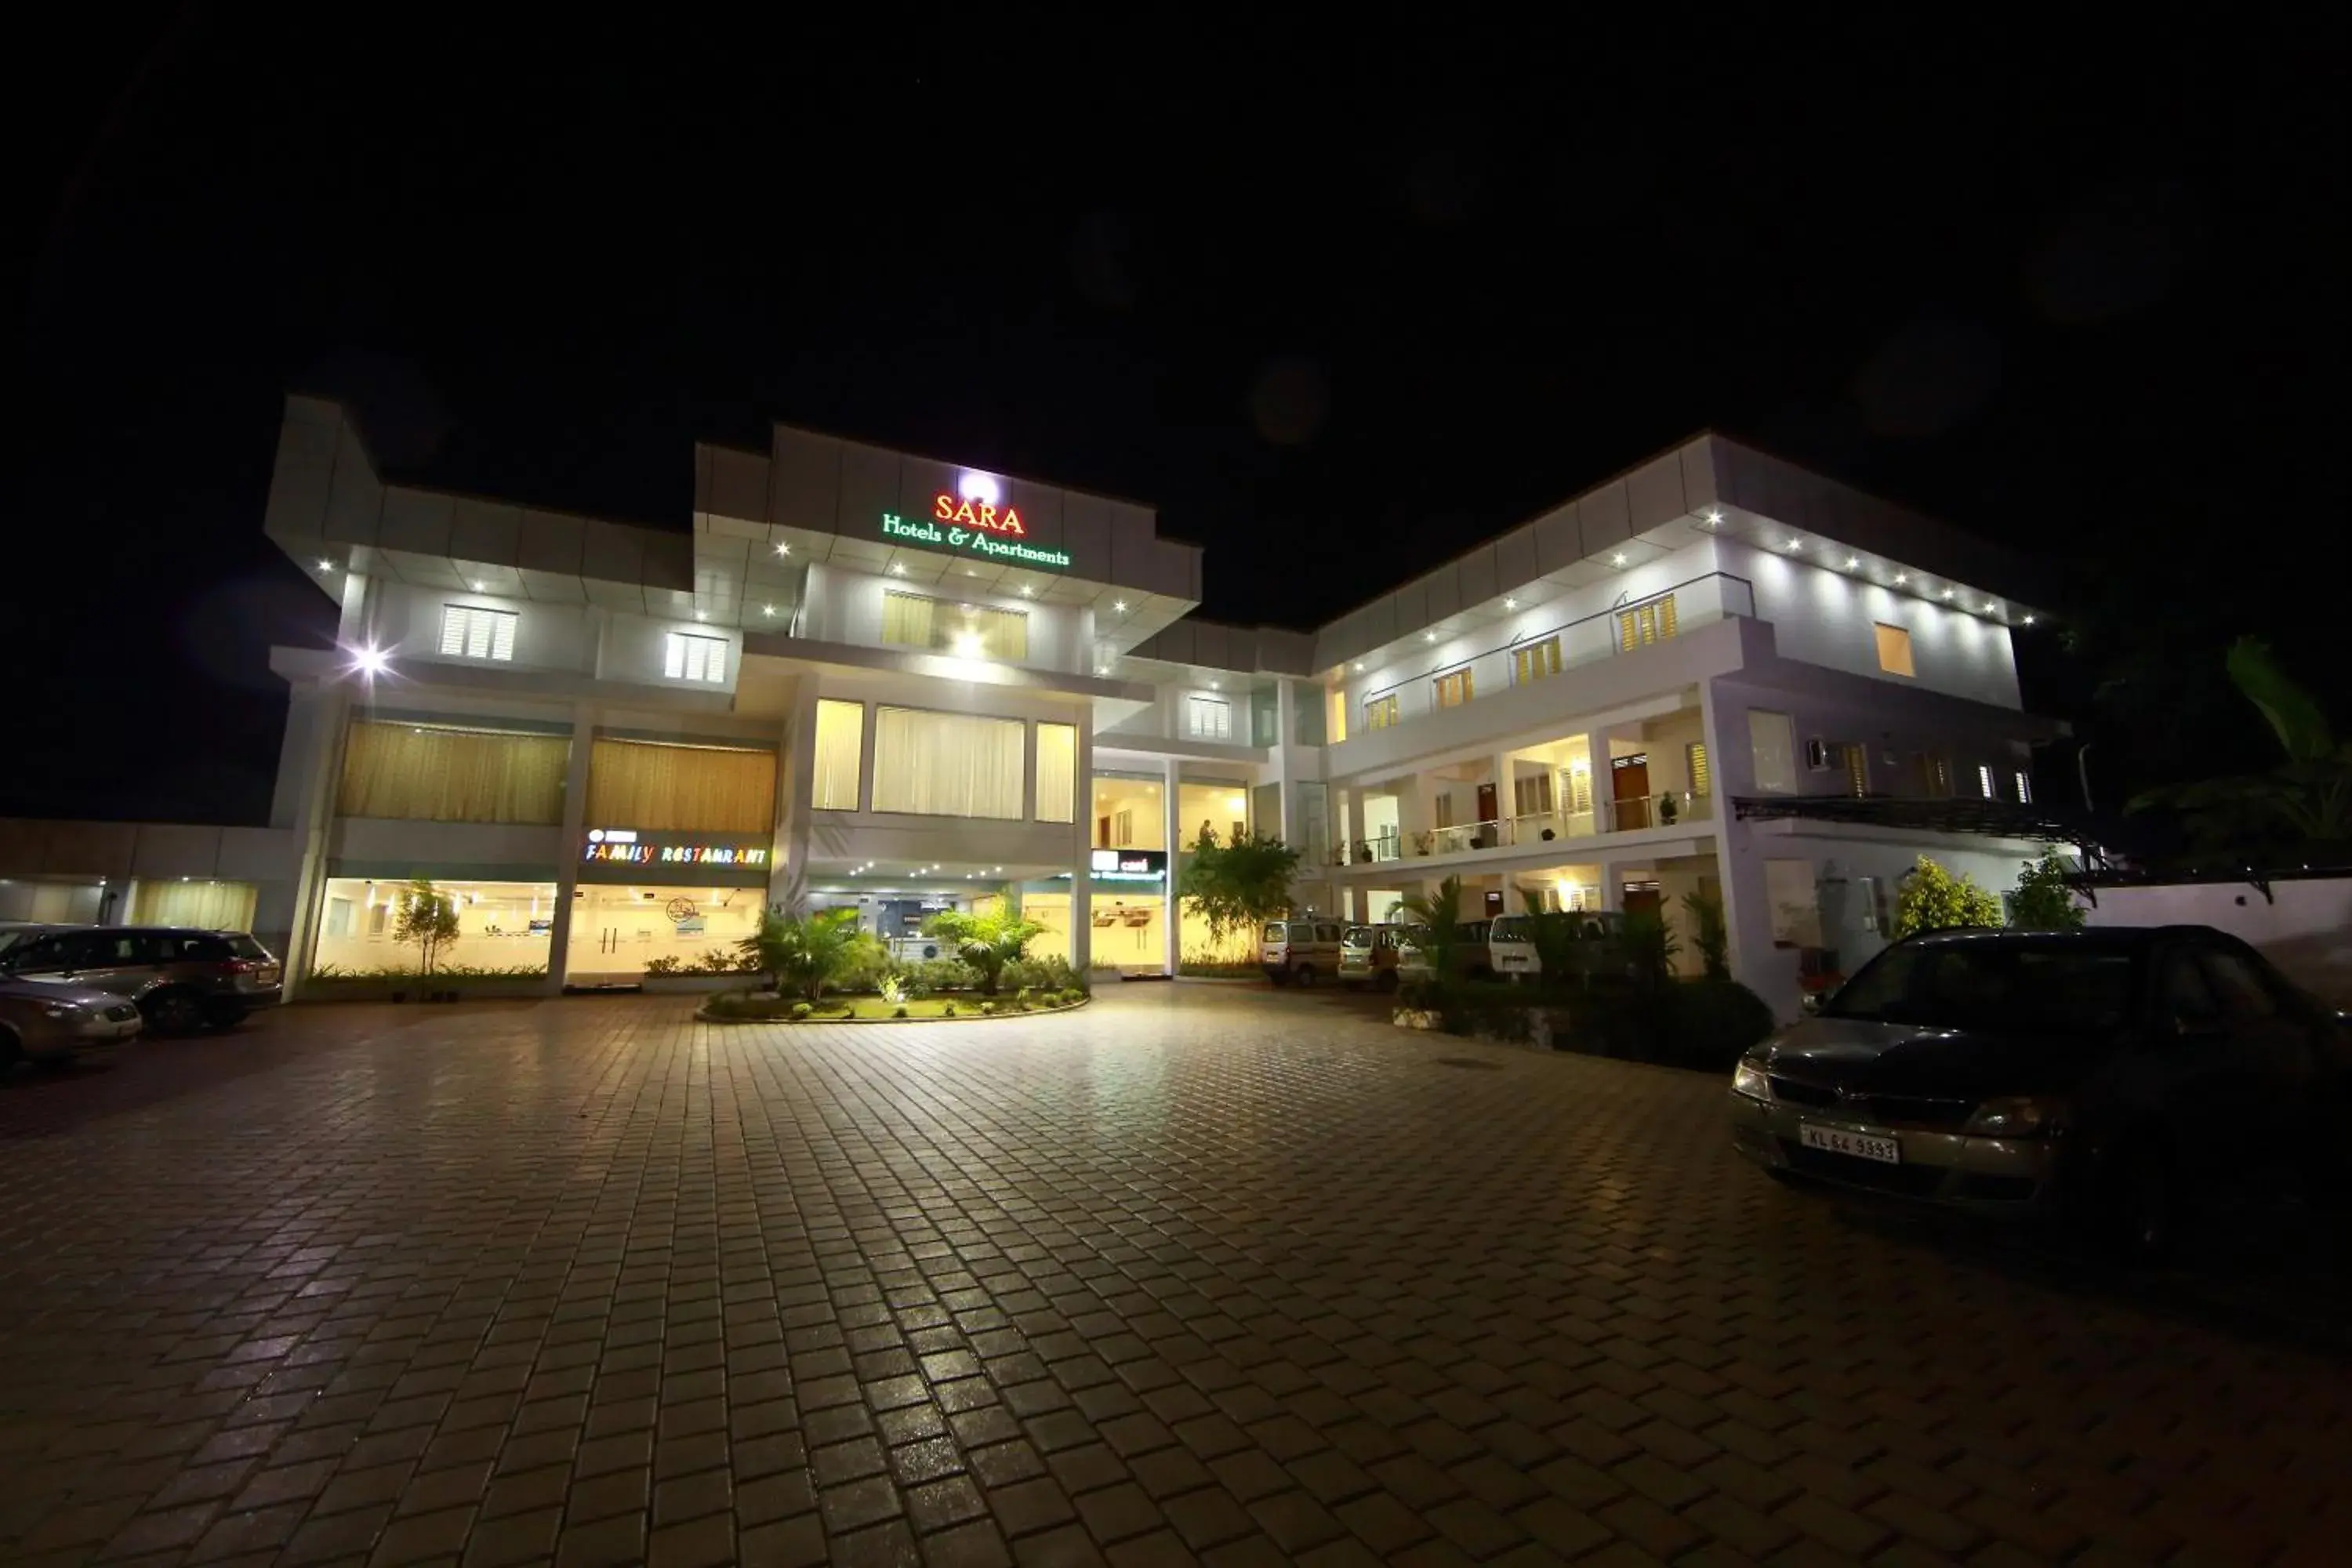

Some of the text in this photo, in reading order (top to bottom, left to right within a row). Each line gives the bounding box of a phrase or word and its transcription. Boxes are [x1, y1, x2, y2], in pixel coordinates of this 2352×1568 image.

[935, 495, 1025, 534] SARA
[883, 514, 1070, 565] Hotels & Apartments
